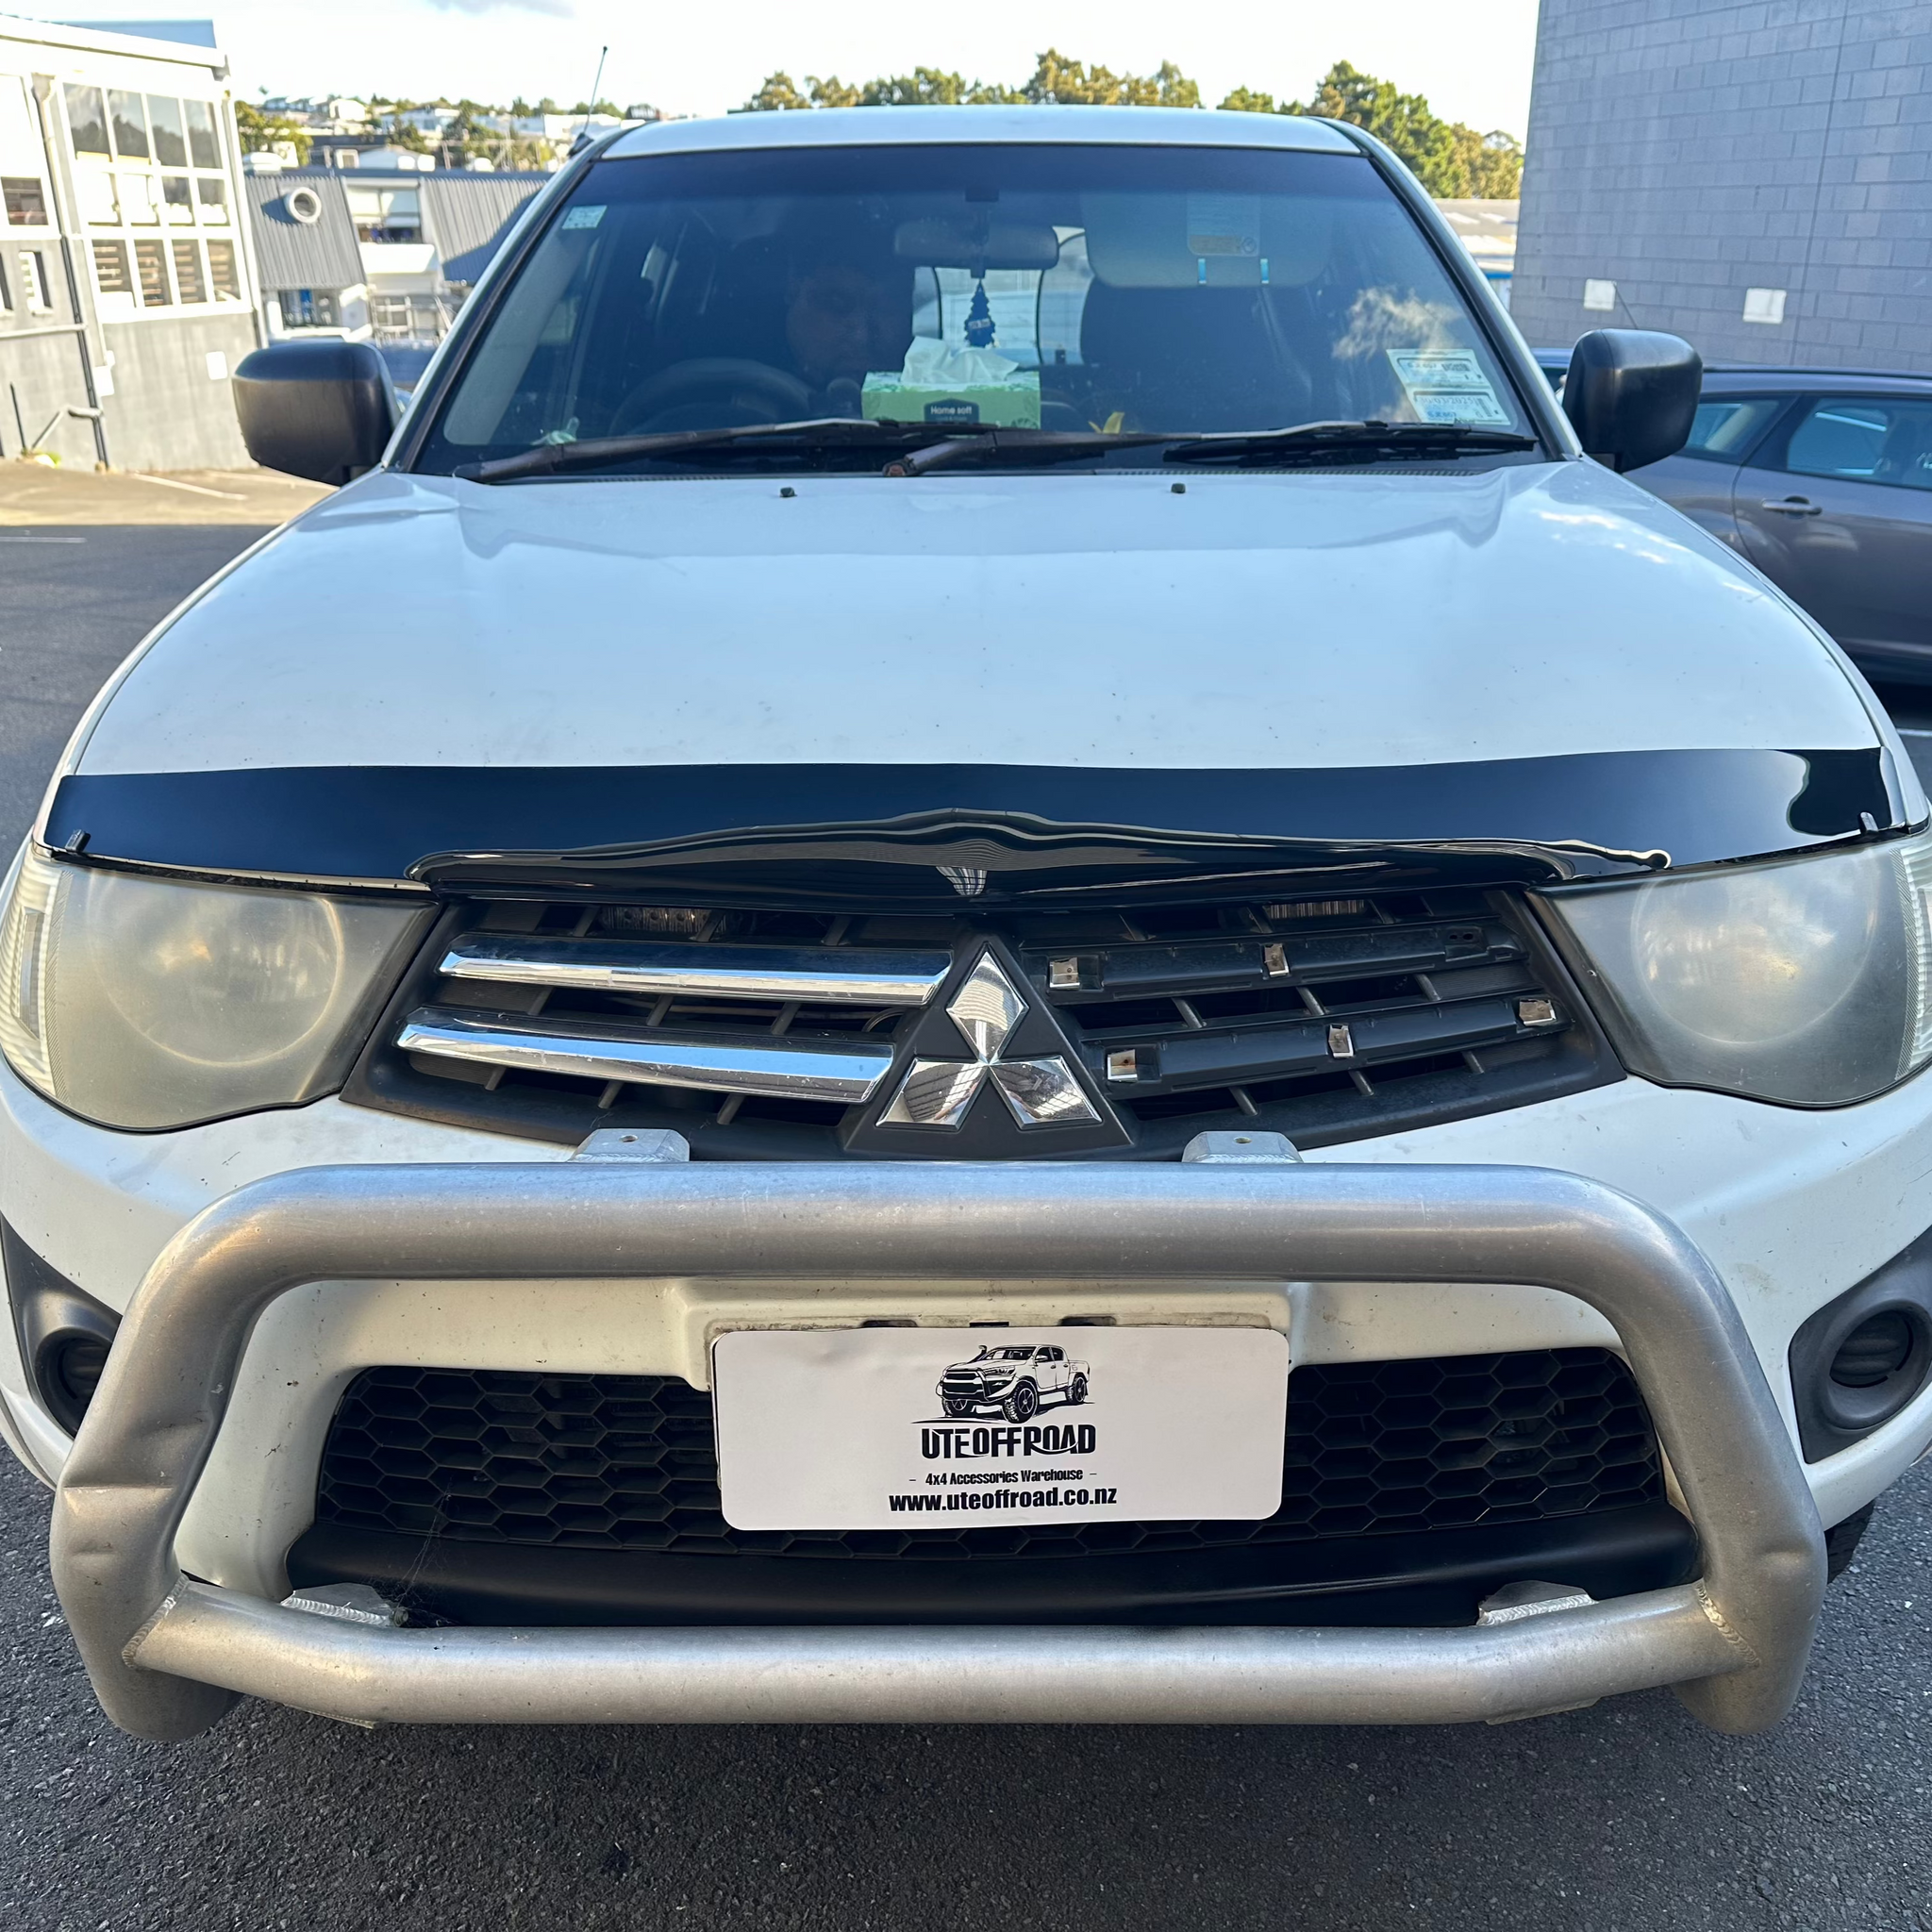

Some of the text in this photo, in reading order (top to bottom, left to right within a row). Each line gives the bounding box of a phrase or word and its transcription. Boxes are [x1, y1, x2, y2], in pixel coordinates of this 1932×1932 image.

[921, 1424, 1096, 1459] UTEOFFROAD
[925, 1469, 1084, 1486] 4x4 Accessories Warehouse
[889, 1487, 1118, 1512] www.uteoffroad.co.nz
